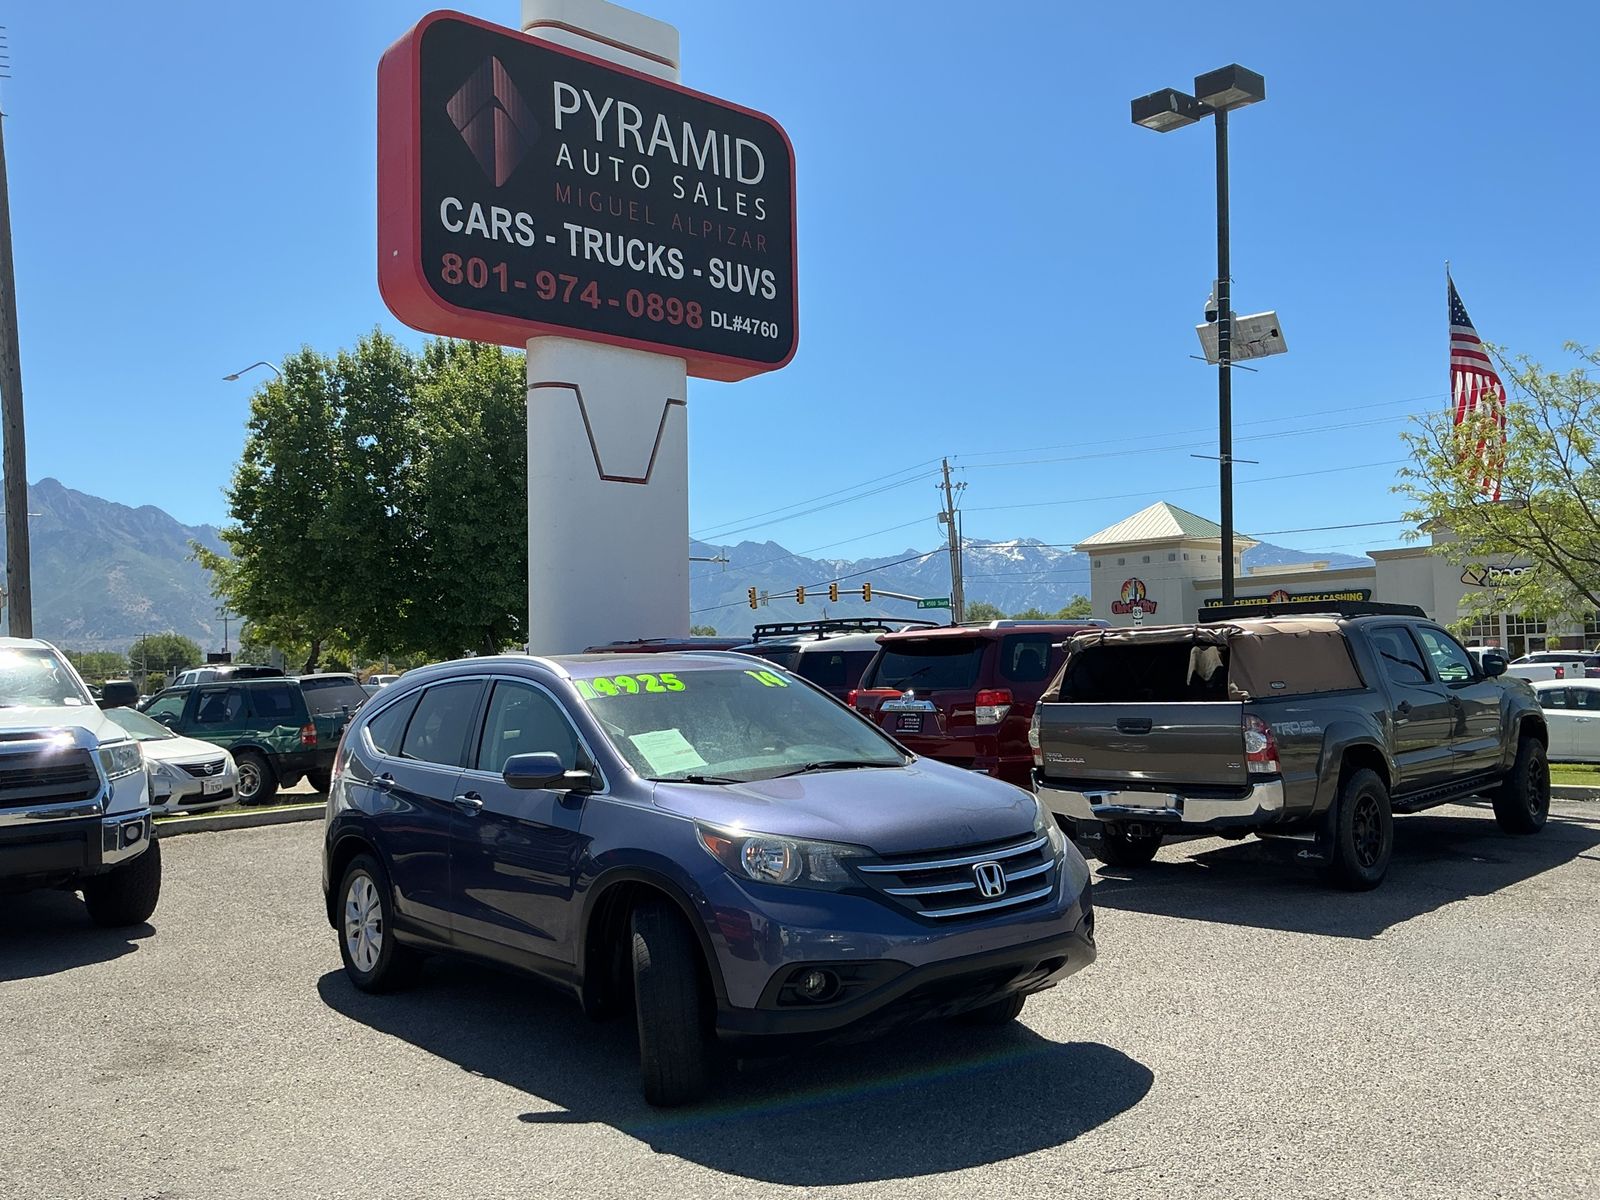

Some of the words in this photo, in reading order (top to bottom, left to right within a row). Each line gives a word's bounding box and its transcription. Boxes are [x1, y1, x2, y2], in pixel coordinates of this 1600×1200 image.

[553, 80, 765, 185] PYRAMID
[556, 143, 650, 189] AUTO
[673, 175, 766, 221] SALES
[556, 182, 655, 225] MIGUEL
[672, 213, 767, 253] ALPIZAR
[440, 197, 535, 247] CARS
[563, 222, 685, 280] TRUCKS
[709, 257, 776, 300] SUVS
[710, 310, 778, 339] DL#4760
[1323, 592, 1363, 601] CASHING
[574, 673, 686, 700] 14925
[1271, 721, 1300, 735] TRD
